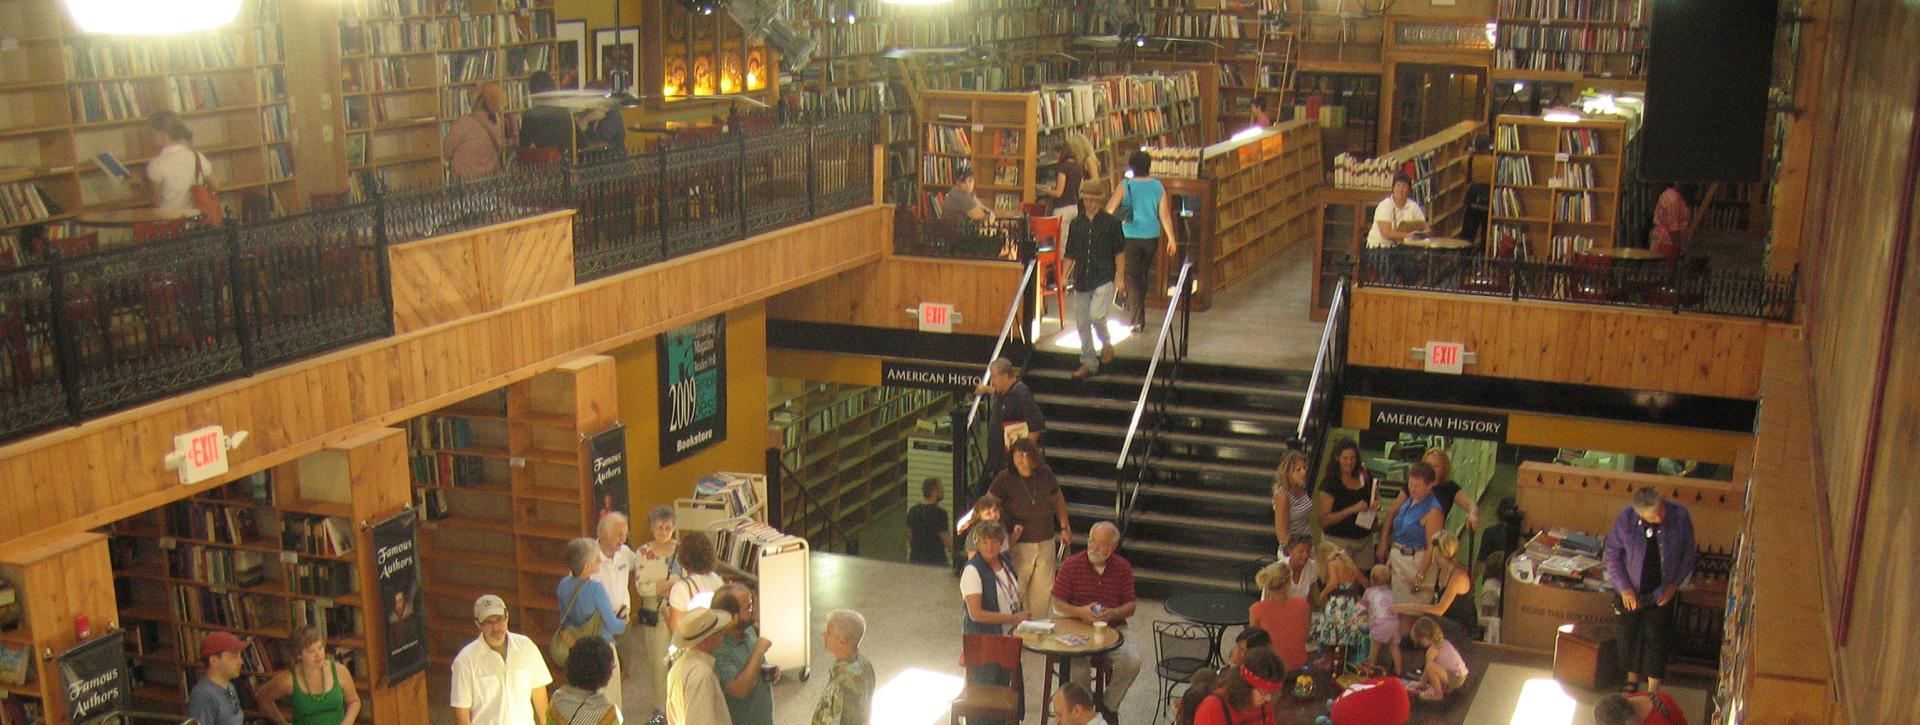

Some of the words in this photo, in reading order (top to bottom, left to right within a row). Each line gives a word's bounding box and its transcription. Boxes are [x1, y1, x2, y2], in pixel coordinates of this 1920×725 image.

[925, 305, 947, 325] EXIT
[1432, 344, 1458, 366] EXIT
[887, 368, 945, 384] AMERICAN
[948, 373, 982, 387] HISTO
[668, 376, 697, 432] 2009
[1376, 411, 1443, 429] AMERICAN
[1447, 416, 1501, 434] HISTORY
[192, 431, 220, 468] EXIT
[676, 429, 713, 452] Bookstore
[593, 452, 622, 472] Famous
[594, 466, 622, 485] Authors
[377, 539, 413, 564] Famous
[379, 555, 413, 580] Authors
[69, 668, 119, 700] Famous
[73, 687, 119, 719] Authors
